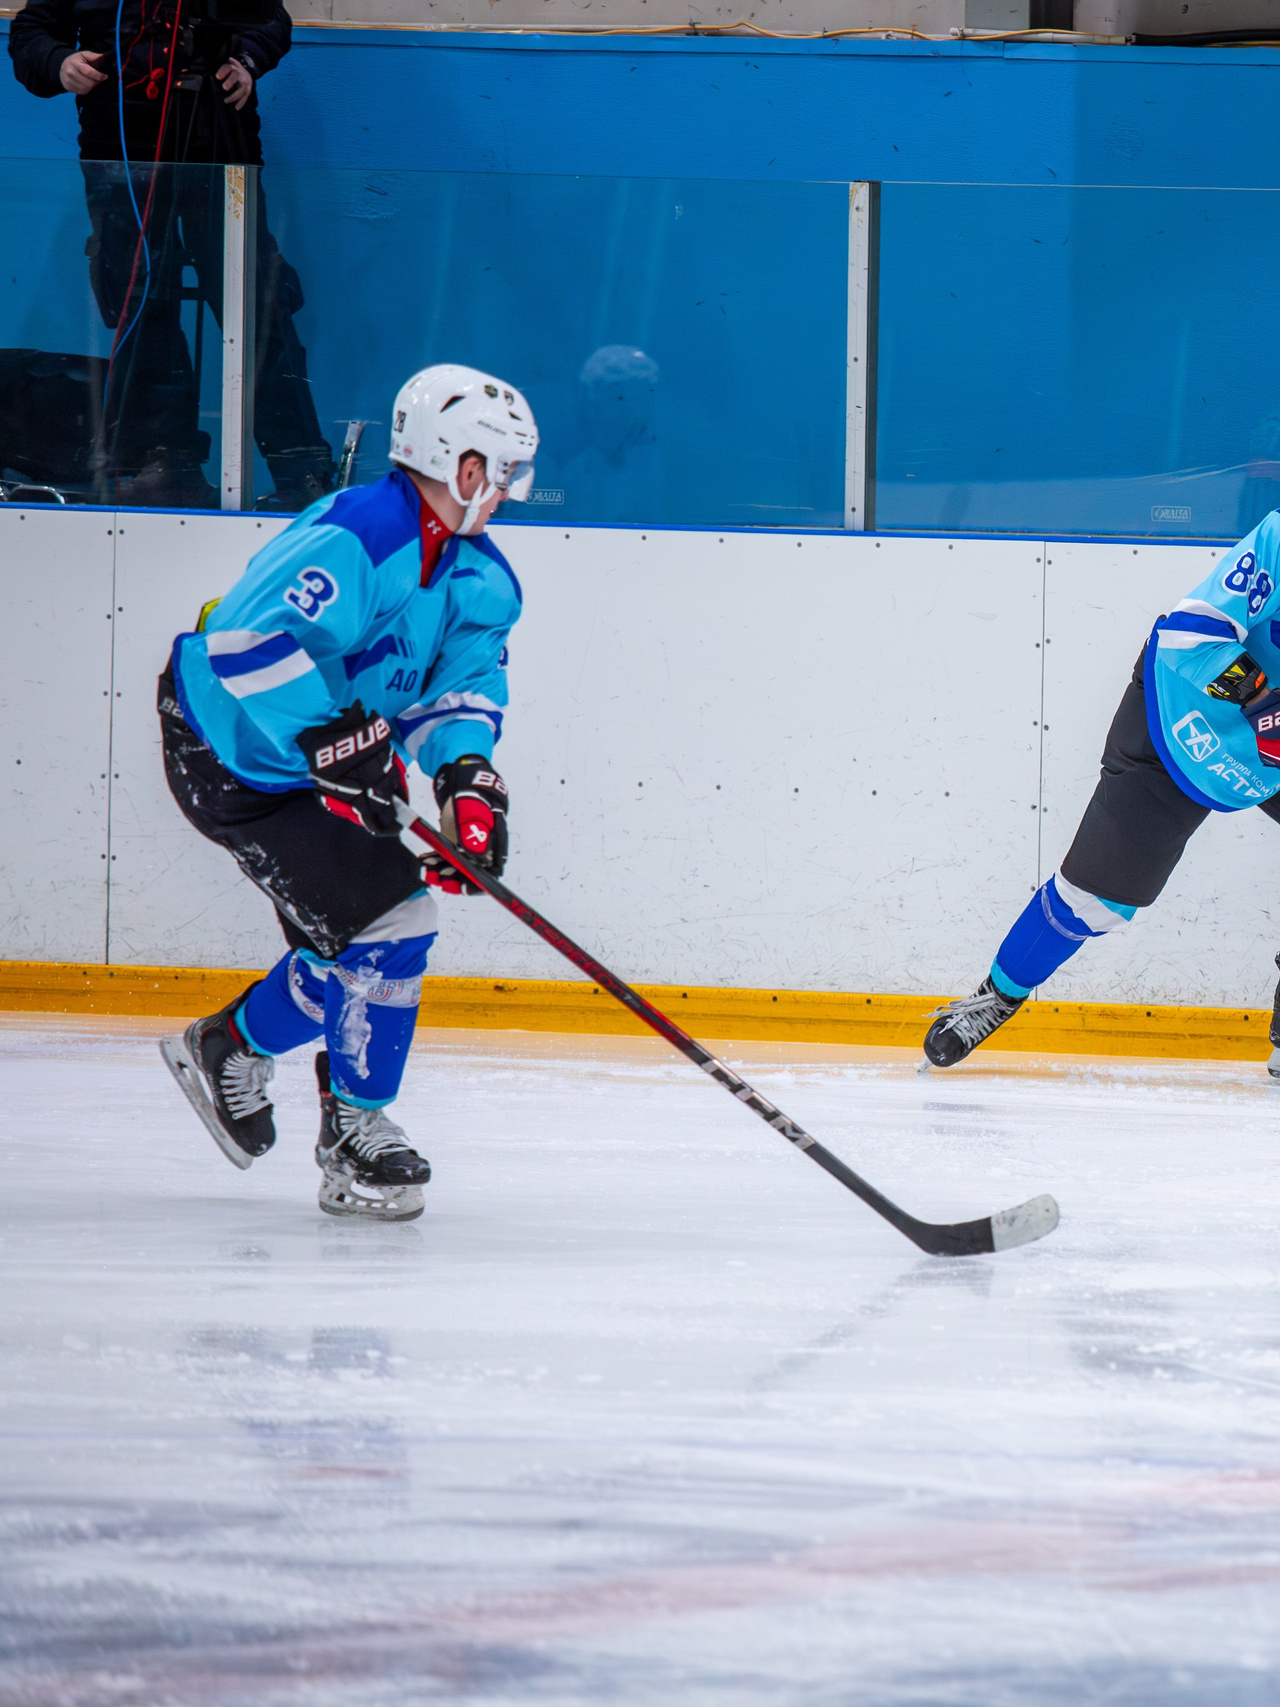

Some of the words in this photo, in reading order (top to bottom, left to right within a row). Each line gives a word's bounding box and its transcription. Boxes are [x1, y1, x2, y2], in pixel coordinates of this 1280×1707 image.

[284, 566, 339, 621] 3
[1222, 548, 1275, 618] 88
[314, 716, 391, 770] BAUE
[1207, 763, 1262, 798] АСТР
[1221, 753, 1252, 777] ГРУППА
[1251, 774, 1273, 798] КОМ
[700, 1057, 816, 1151] CCM
